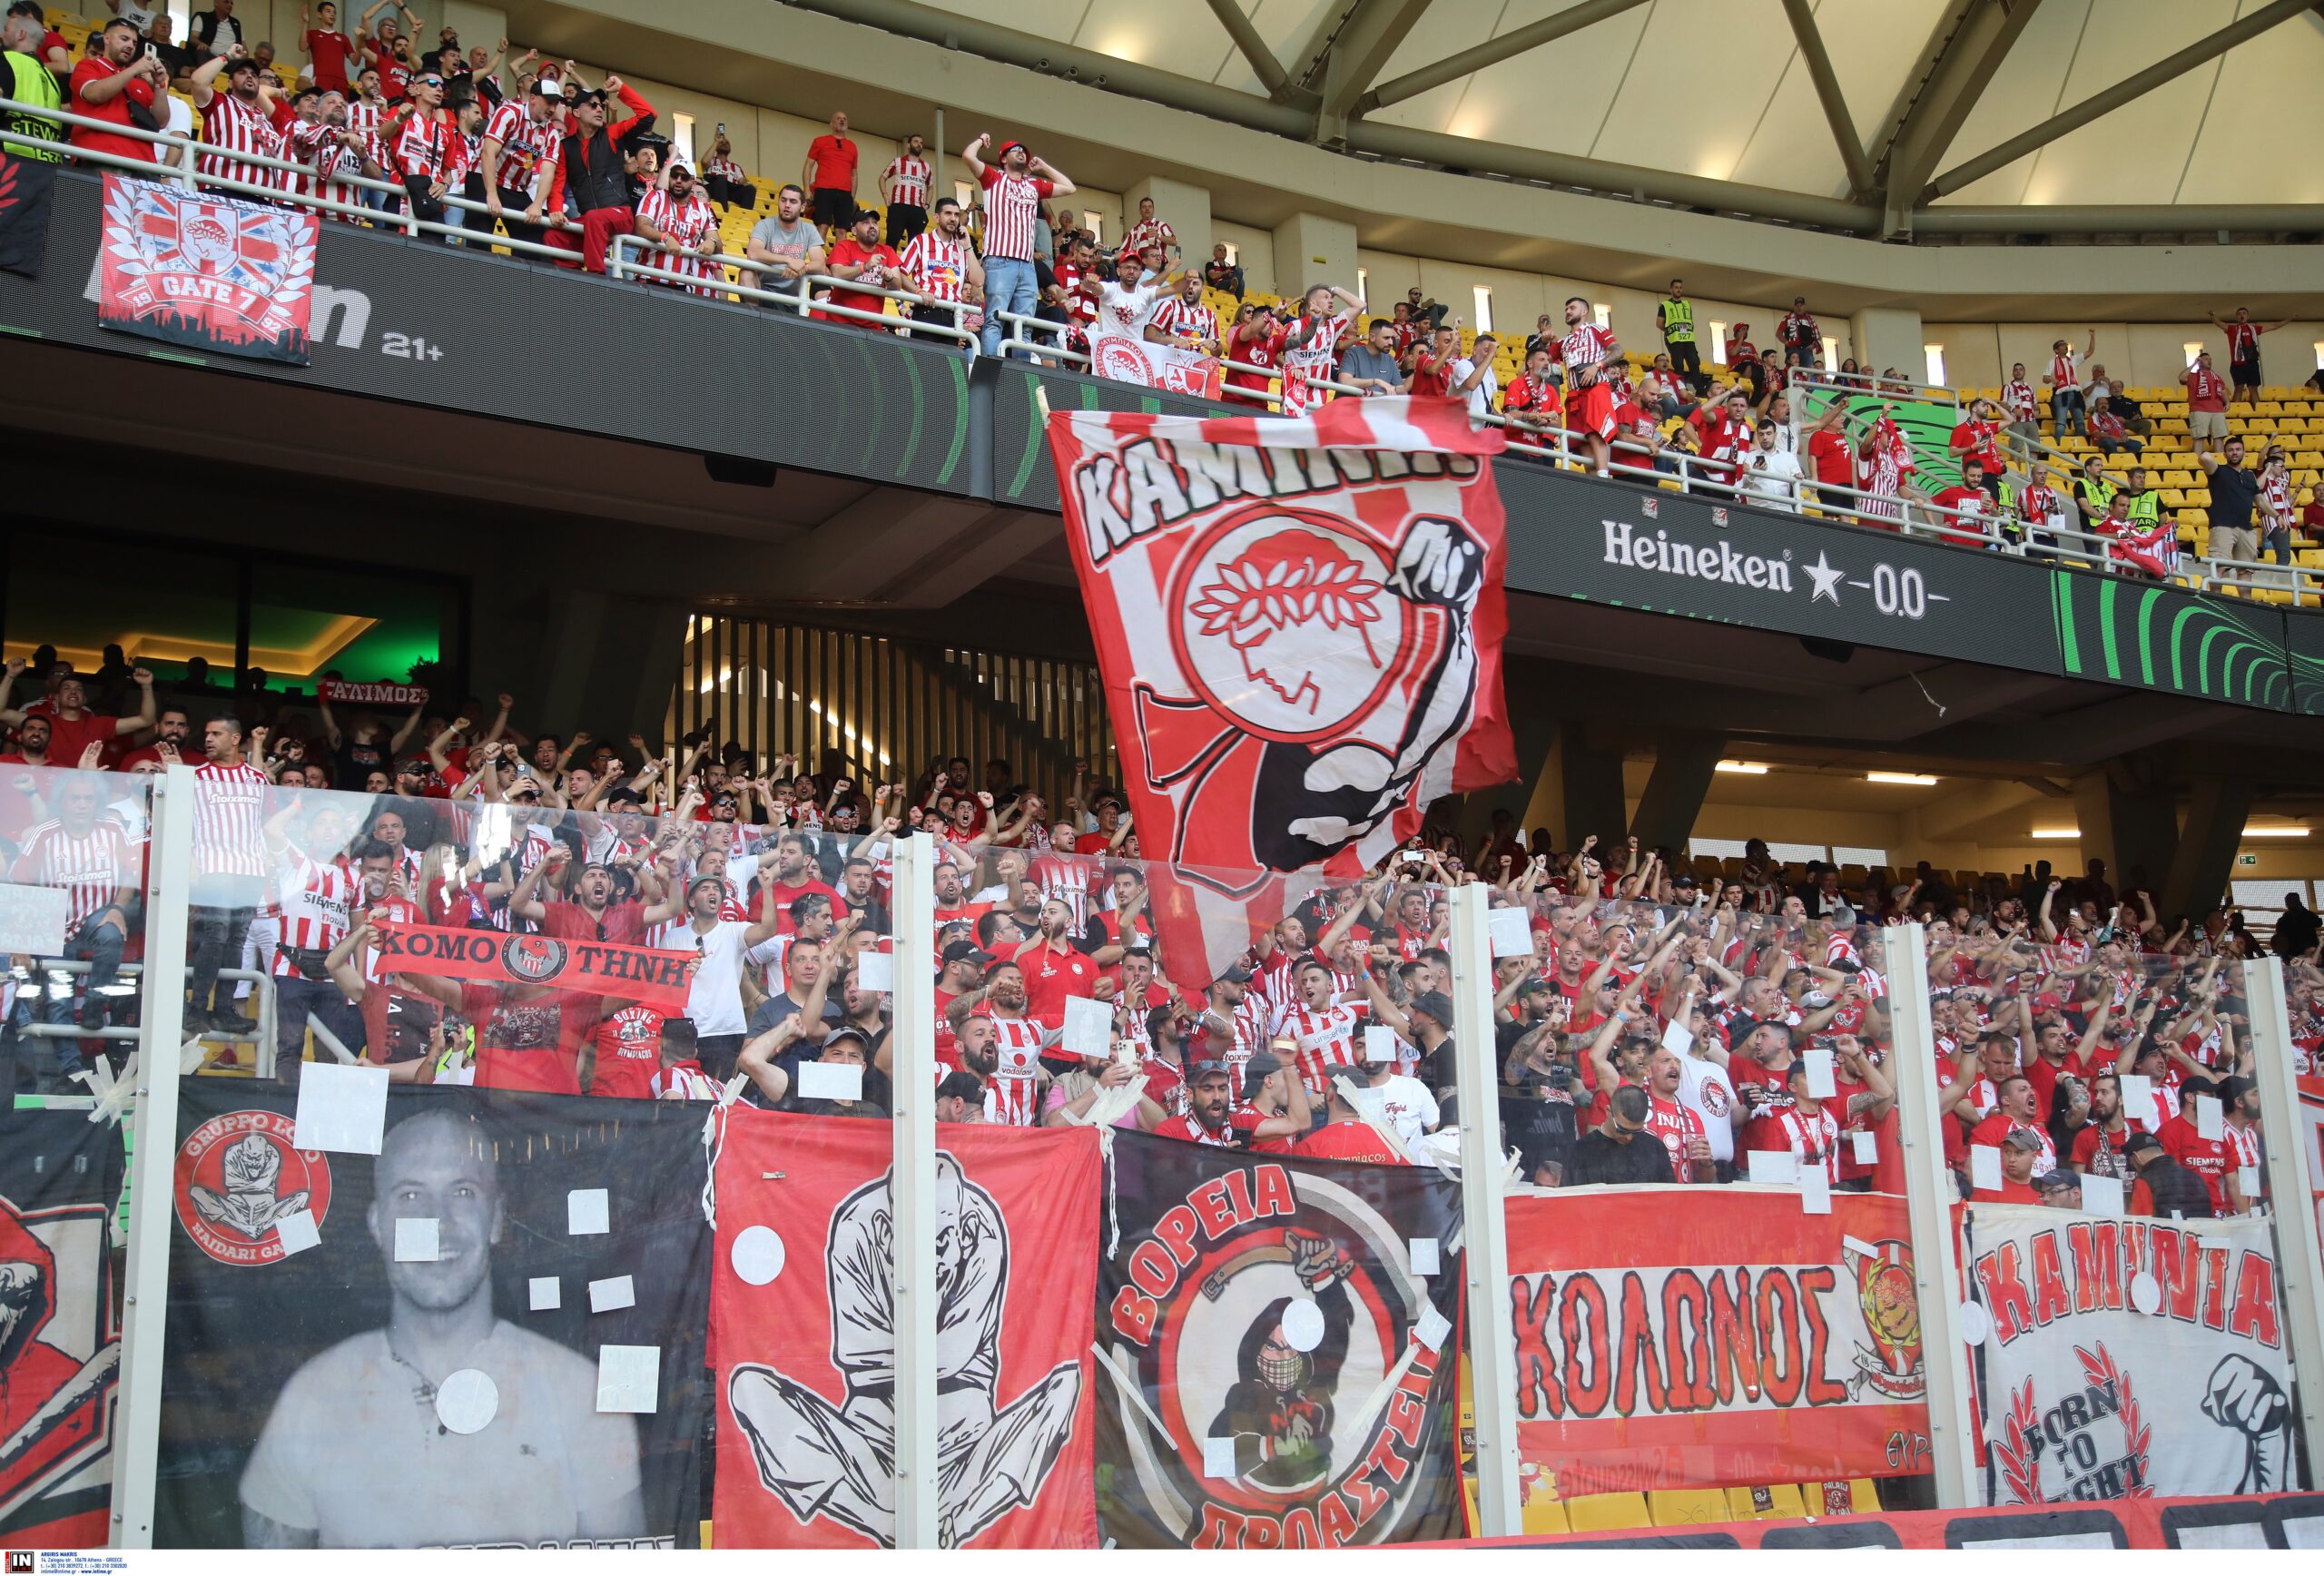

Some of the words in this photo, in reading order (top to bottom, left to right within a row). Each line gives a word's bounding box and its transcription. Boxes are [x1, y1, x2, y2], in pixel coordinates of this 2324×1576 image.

[162, 276, 233, 303] GATE
[238, 292, 257, 310] 7
[261, 318, 281, 332] 92
[381, 332, 443, 361] 21+
[1601, 519, 1793, 593] Heineken
[209, 793, 261, 805] Stoiximan
[56, 869, 111, 883] Stoiximan
[303, 892, 349, 915] SIEMENS
[614, 1007, 656, 1024] BOXING
[1314, 1026, 1339, 1044] unicef
[1223, 1050, 1252, 1062] toixim
[1001, 1067, 1032, 1076] vodafone
[1385, 1101, 1407, 1114] Fight
[186, 1114, 269, 1157] GRUPPO
[2186, 1157, 2225, 1167] SIEMENS
[192, 1222, 256, 1260] HAIDARI
[1510, 1266, 1848, 1420] ΚΟΛΩΝΟΣ
[2023, 1379, 2121, 1463] BORN
[2056, 1431, 2097, 1481] TO
